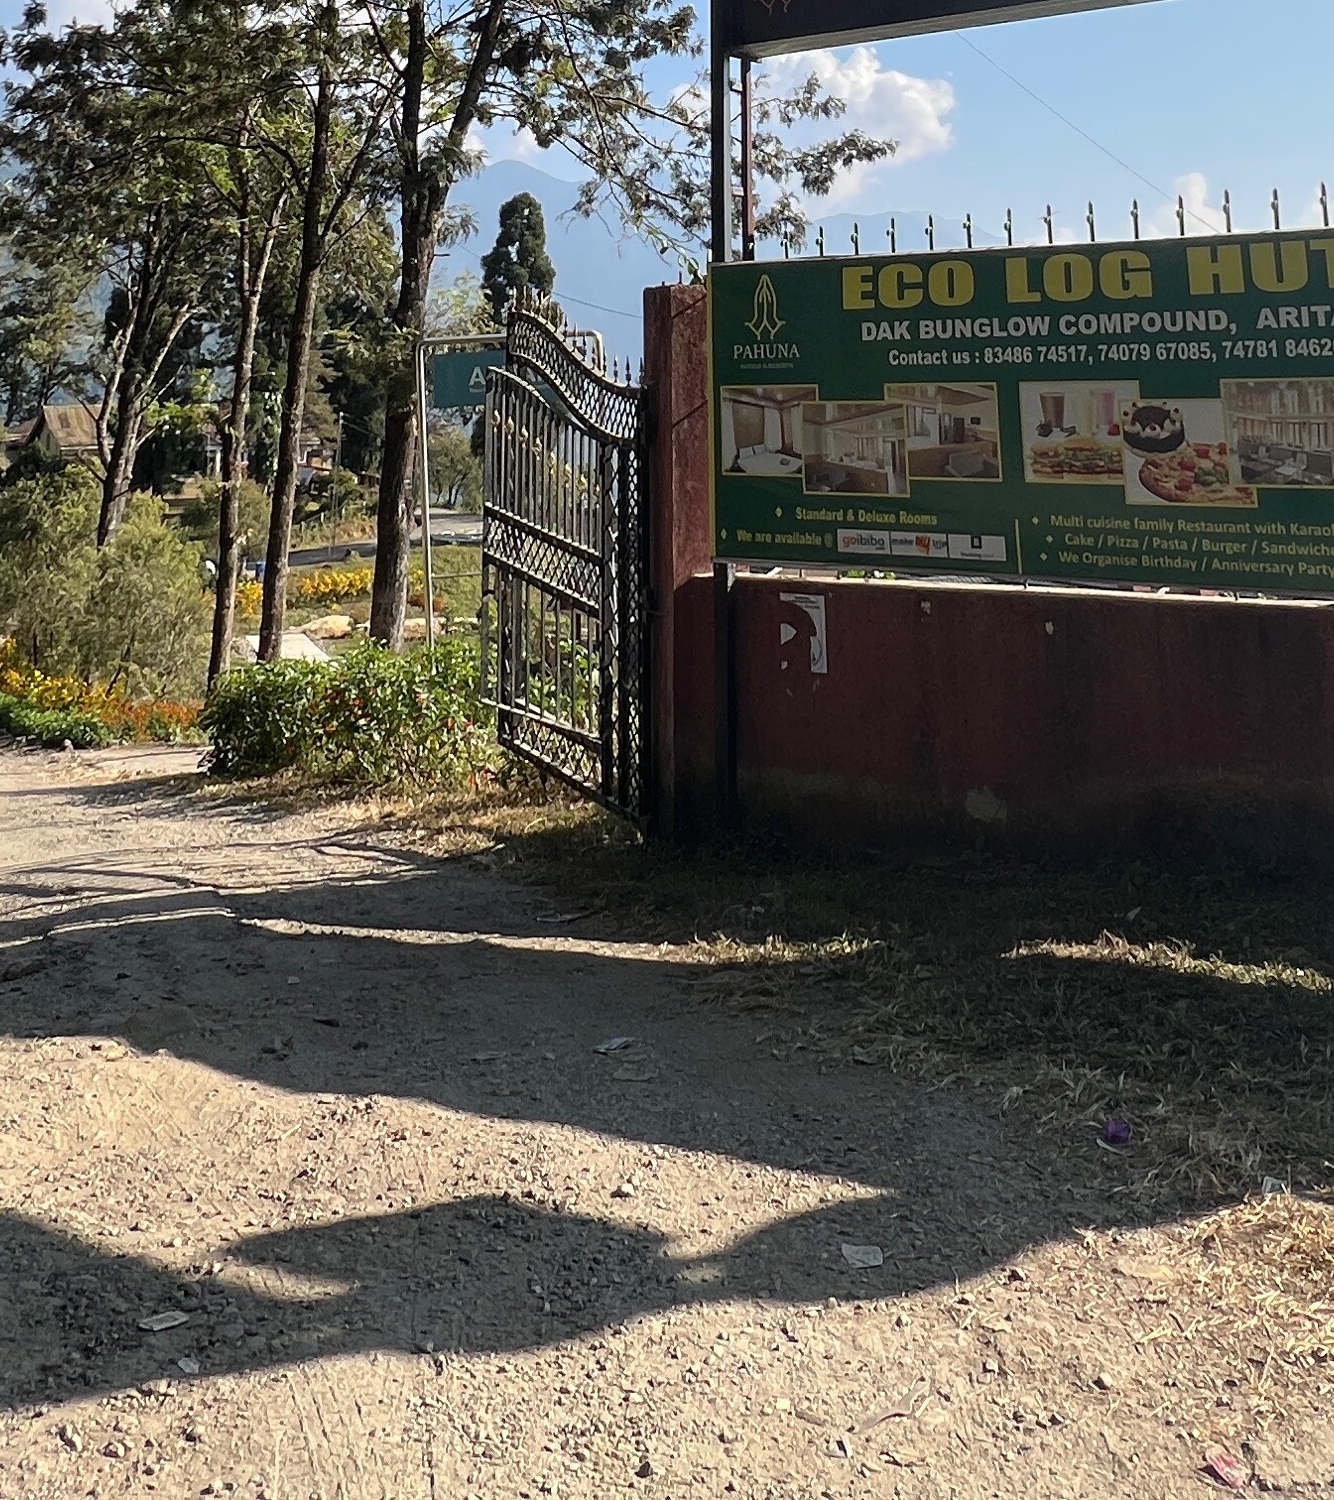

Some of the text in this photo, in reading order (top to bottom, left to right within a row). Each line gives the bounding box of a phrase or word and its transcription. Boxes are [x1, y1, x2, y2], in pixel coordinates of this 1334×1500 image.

[842, 260, 975, 310] ECO
[1005, 250, 1153, 303] LOG
[861, 321, 911, 341] DAK
[919, 316, 1051, 339] BUNGLOW
[1059, 309, 1237, 335] COMPOUND,
[733, 343, 800, 359] PAHUNA
[888, 348, 948, 366] Contact
[952, 351, 971, 364] us
[984, 345, 1032, 363] 83486
[1037, 344, 1093, 365] 74517,
[1097, 343, 1151, 361] 74079
[1155, 341, 1217, 362] 67085,
[1222, 340, 1278, 359] 74781
[795, 507, 938, 526] Standard & Deluxe Rooms
[1050, 514, 1084, 528] Multi
[1087, 517, 1131, 529] cuisine
[1134, 517, 1174, 533] family
[1177, 517, 1250, 534] Restaurant
[1254, 521, 1286, 535] with
[736, 529, 752, 542] We
[755, 532, 772, 543] are
[774, 532, 822, 546] available
[842, 534, 885, 548] goibibo
[1064, 533, 1094, 546] Cake
[1107, 535, 1139, 548] Pizza
[1152, 536, 1188, 551] Pasta
[1201, 539, 1247, 555] Burger
[1058, 551, 1079, 564] We
[1082, 552, 1138, 568] Organise
[1141, 554, 1197, 572] Birthday
[1211, 558, 1295, 576] Anniversary
